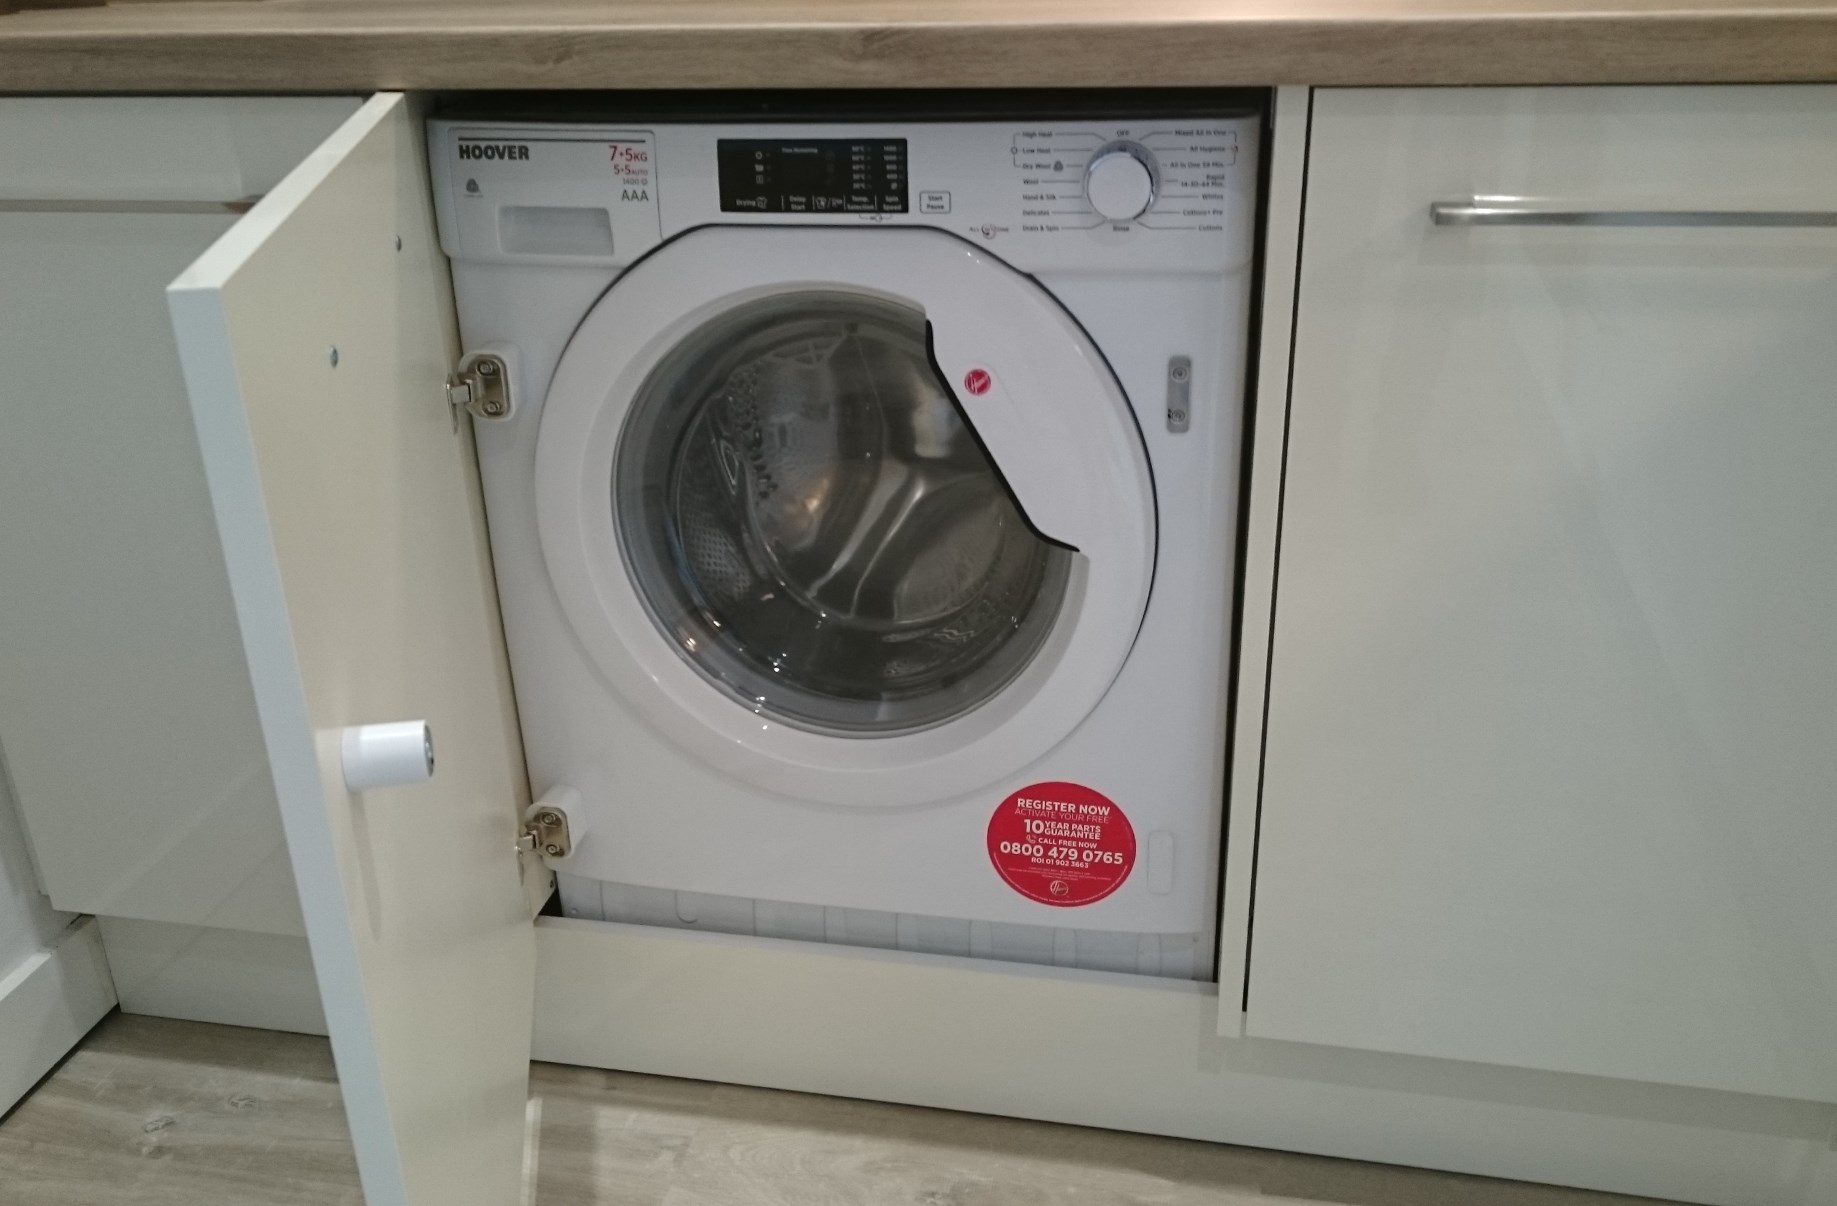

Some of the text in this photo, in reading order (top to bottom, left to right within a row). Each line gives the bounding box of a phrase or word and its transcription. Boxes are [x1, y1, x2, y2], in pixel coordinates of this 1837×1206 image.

[1022, 131, 1037, 139] High
[458, 144, 530, 161] HOOVER
[622, 177, 640, 186] 1400
[621, 188, 650, 202] AAA
[1202, 193, 1224, 201] Whites
[1022, 209, 1050, 217] Delicates
[1045, 225, 1060, 233] Spin
[1112, 224, 1130, 232] Rinse
[1198, 224, 1223, 232] Cottons
[1017, 798, 1110, 816] REGISTER NOW
[1014, 807, 1056, 819] ACTIVATE
[1059, 811, 1085, 822] YOUR
[1024, 818, 1044, 835] 10
[1044, 821, 1101, 833] YEAR PARTS
[1044, 828, 1101, 840] GUARANTEE
[1038, 837, 1098, 849] CALL FREE NOW
[1000, 841, 1123, 865] 0800 479 0765
[1045, 857, 1054, 865] 01
[1055, 859, 1070, 867] 902
[1070, 860, 1089, 869] 3663
